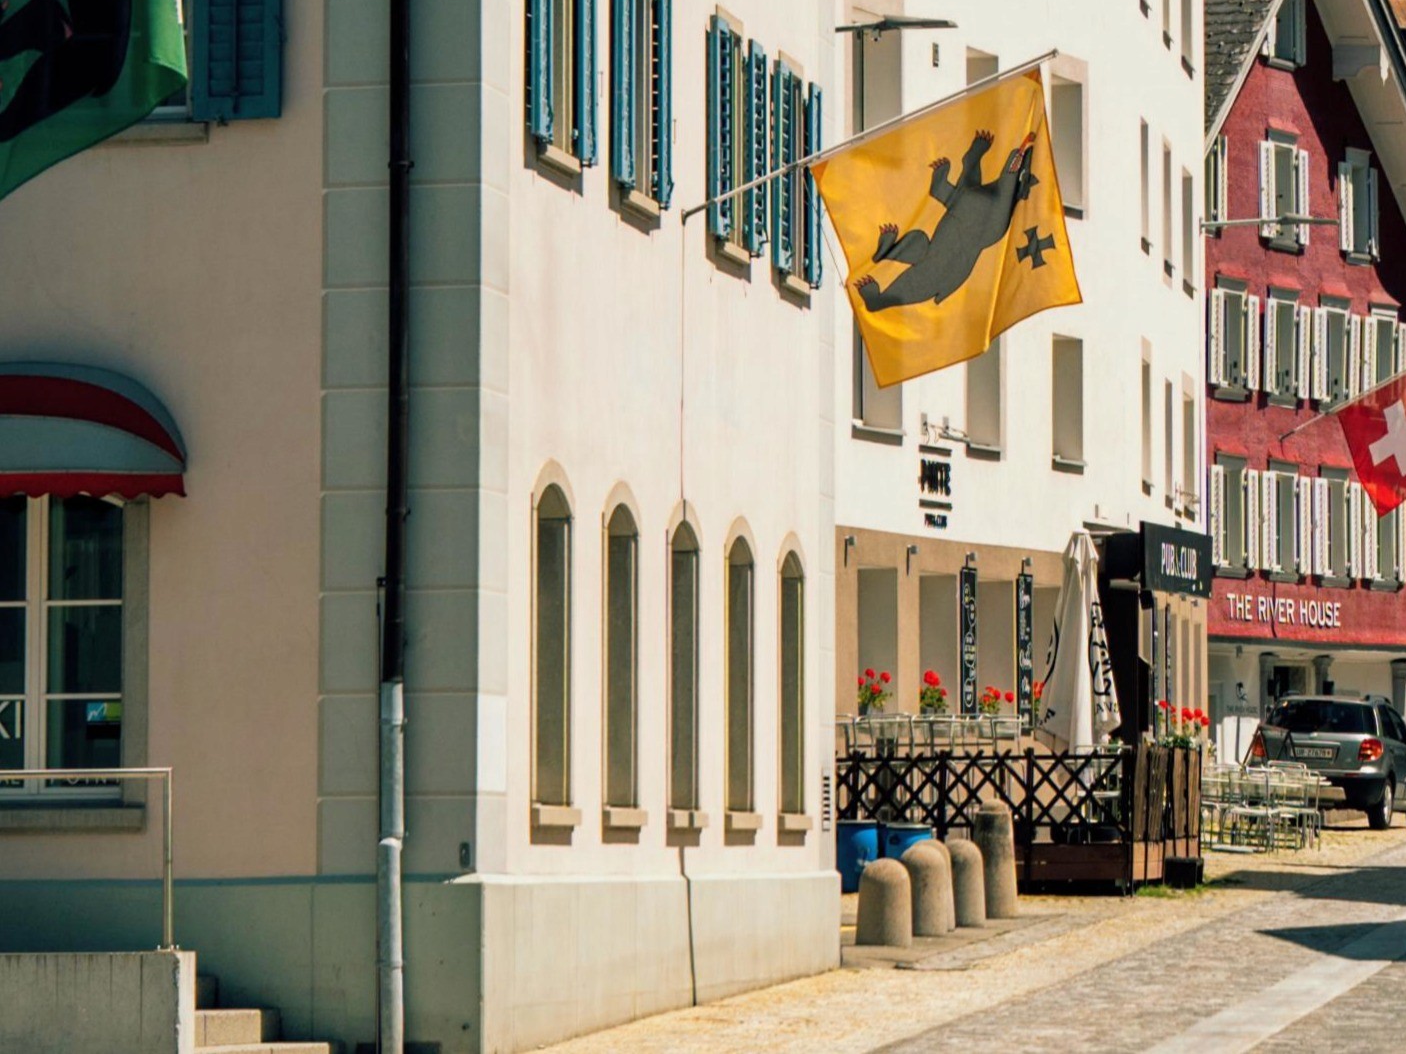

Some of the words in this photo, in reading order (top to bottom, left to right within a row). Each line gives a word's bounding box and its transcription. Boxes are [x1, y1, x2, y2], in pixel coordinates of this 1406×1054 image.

[1226, 593, 1253, 621] THE
[1258, 597, 1295, 625] RIVER
[1299, 600, 1342, 627] HOUSE
